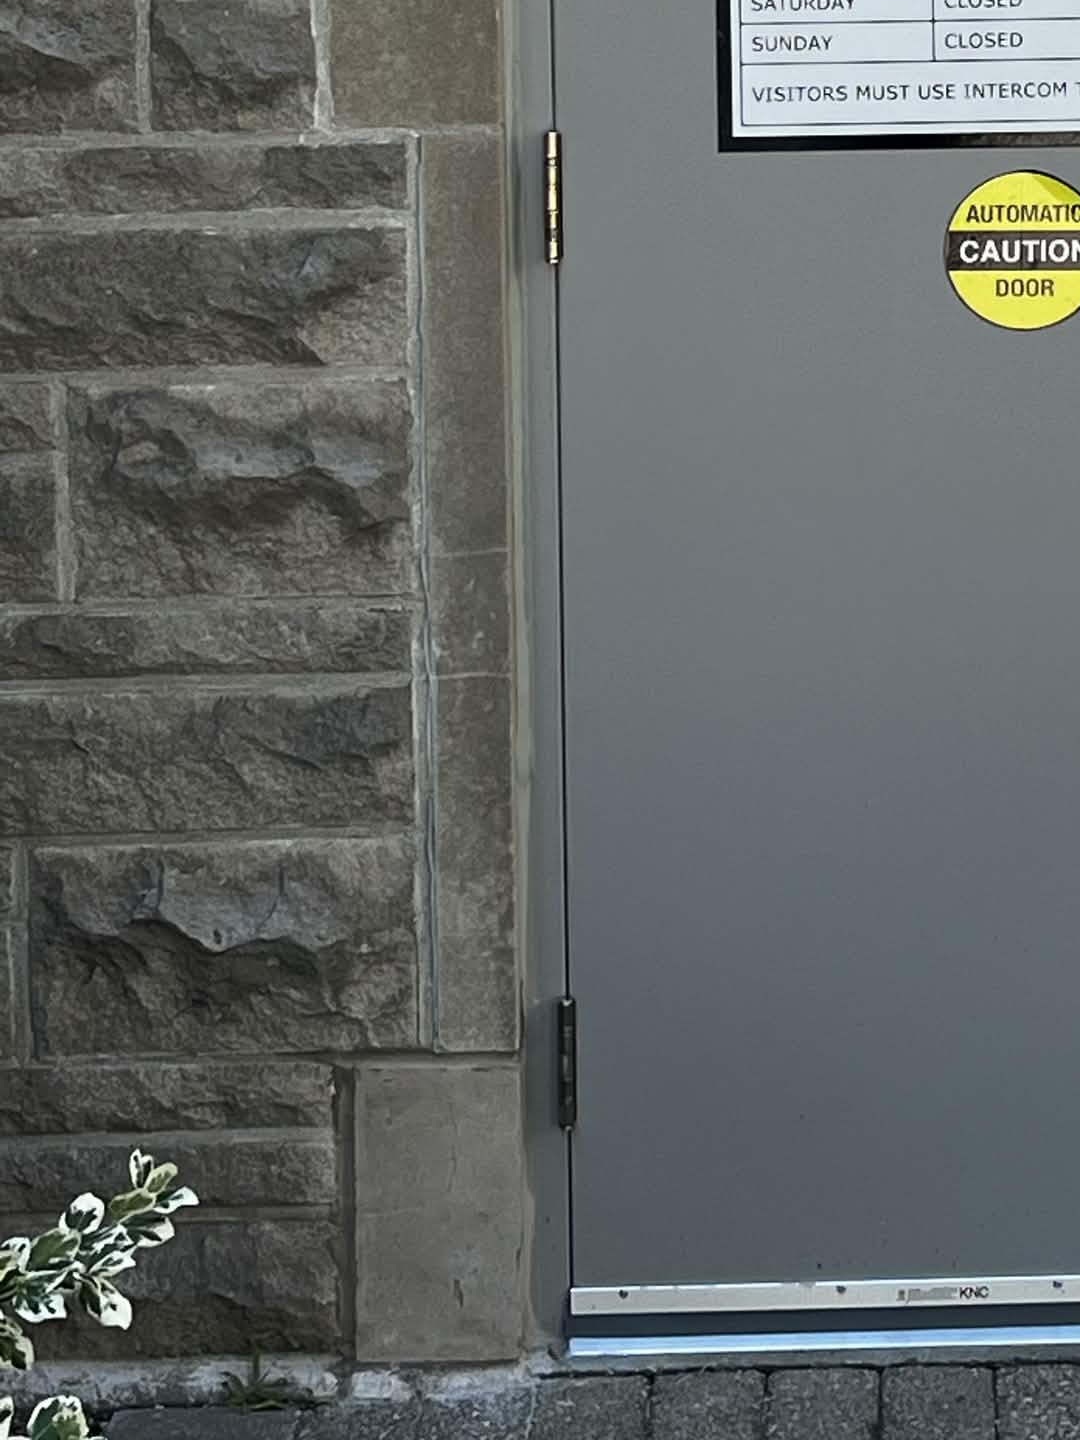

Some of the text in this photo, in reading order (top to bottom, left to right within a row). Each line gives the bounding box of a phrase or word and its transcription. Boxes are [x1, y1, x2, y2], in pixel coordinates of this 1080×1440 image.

[751, 34, 833, 53] SUNDAY
[944, 31, 1024, 50] CLOSED
[751, 84, 849, 104] VISITORS
[855, 84, 911, 101] MUST
[917, 83, 956, 101] USE
[963, 81, 1068, 100] INTERCOM
[995, 278, 1055, 298] DOOR
[959, 1285, 990, 1300] KNC
